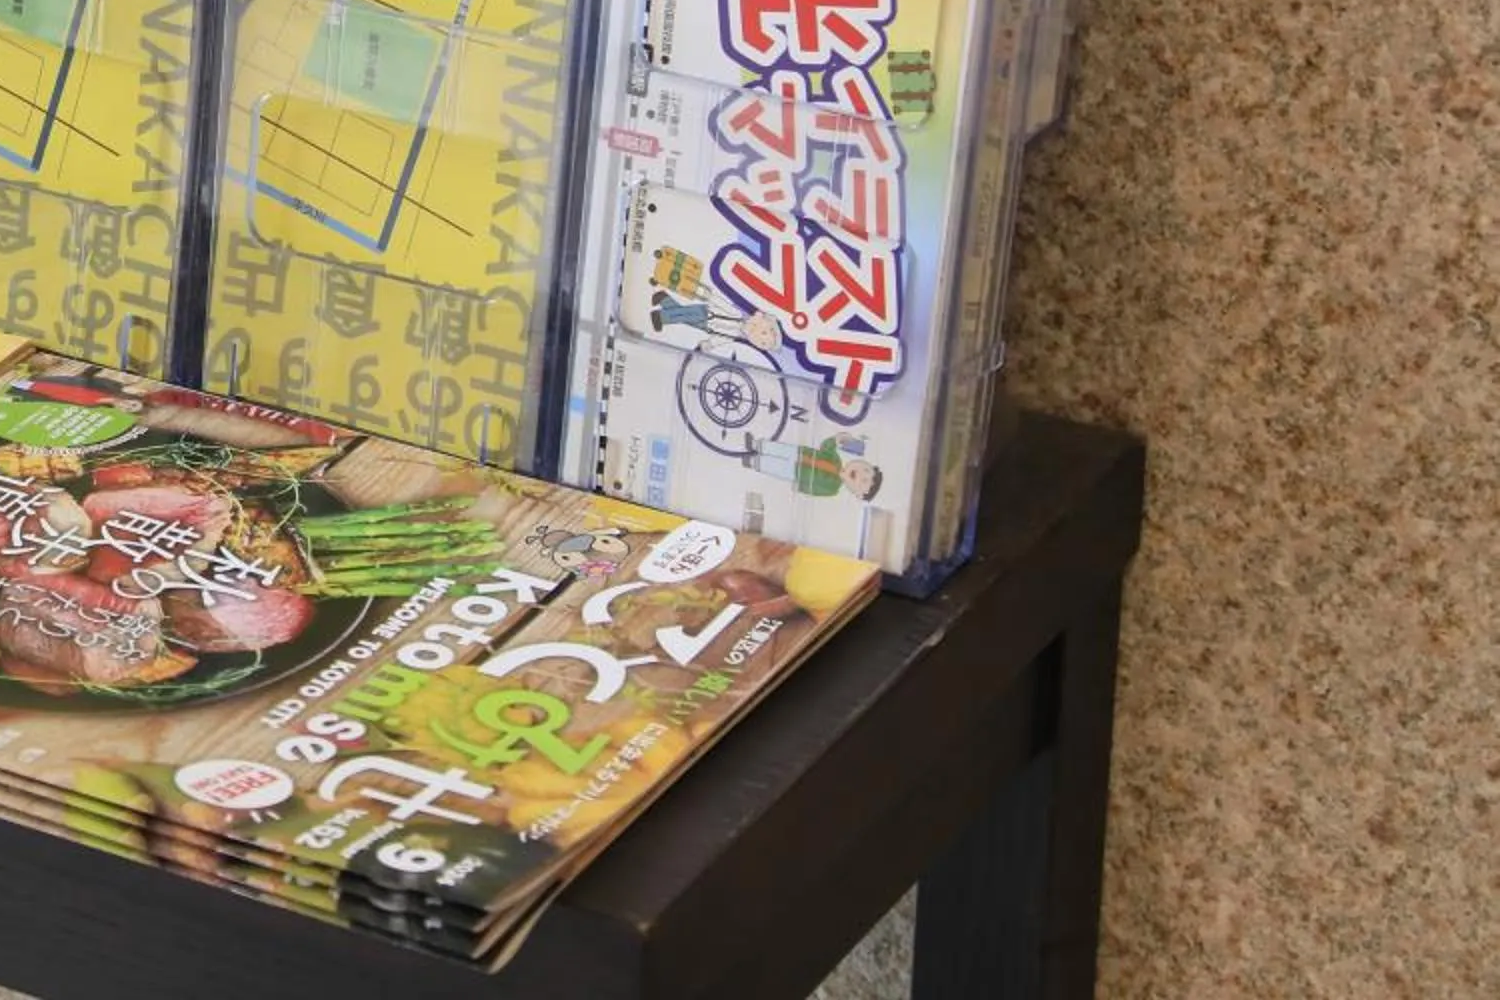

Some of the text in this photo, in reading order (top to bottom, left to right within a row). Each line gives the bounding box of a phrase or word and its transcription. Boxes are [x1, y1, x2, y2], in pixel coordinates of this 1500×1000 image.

[728, 81, 809, 332] マップ
[814, 78, 895, 406] イラスト
[790, 406, 808, 423] N
[257, 576, 455, 730] WELCOME TO KOTO CITY
[719, 617, 783, 665] 江東区の
[318, 579, 731, 835] ことみせ
[202, 767, 277, 806] FREE!
[370, 837, 449, 879] 9
